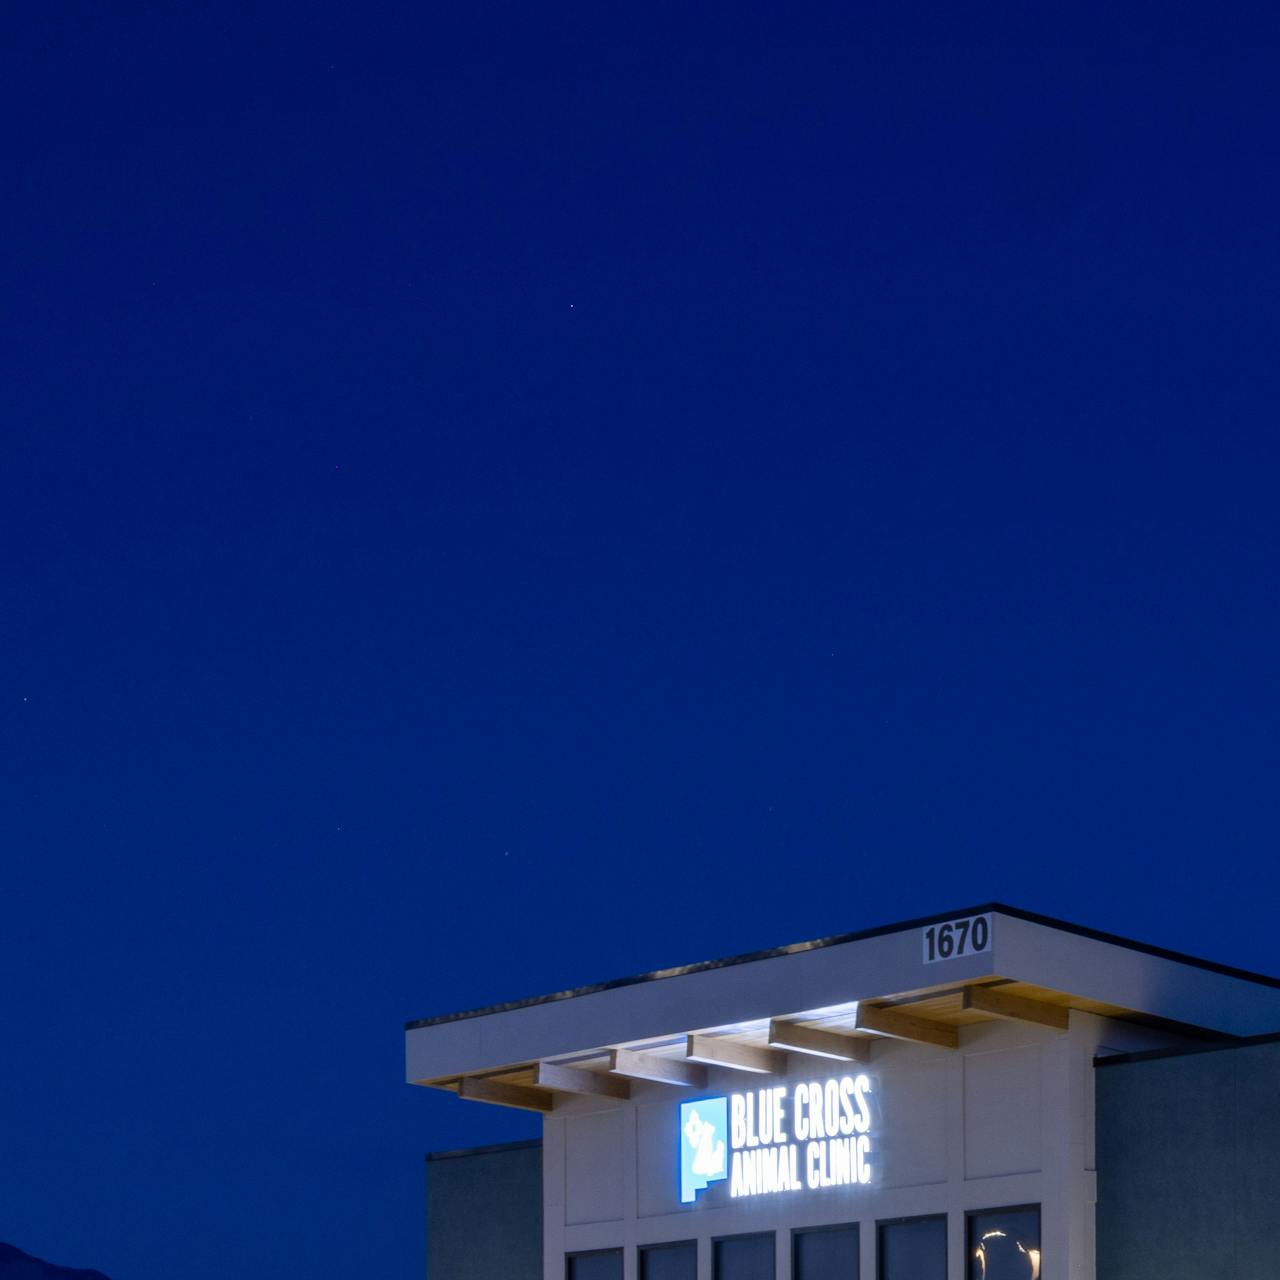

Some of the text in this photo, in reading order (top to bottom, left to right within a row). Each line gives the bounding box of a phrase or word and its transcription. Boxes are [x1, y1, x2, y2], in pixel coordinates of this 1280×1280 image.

[926, 916, 988, 961] 1670
[731, 1075, 871, 1149] BLUE CROSS
[730, 1135, 871, 1198] ANIMAL CLINIC
